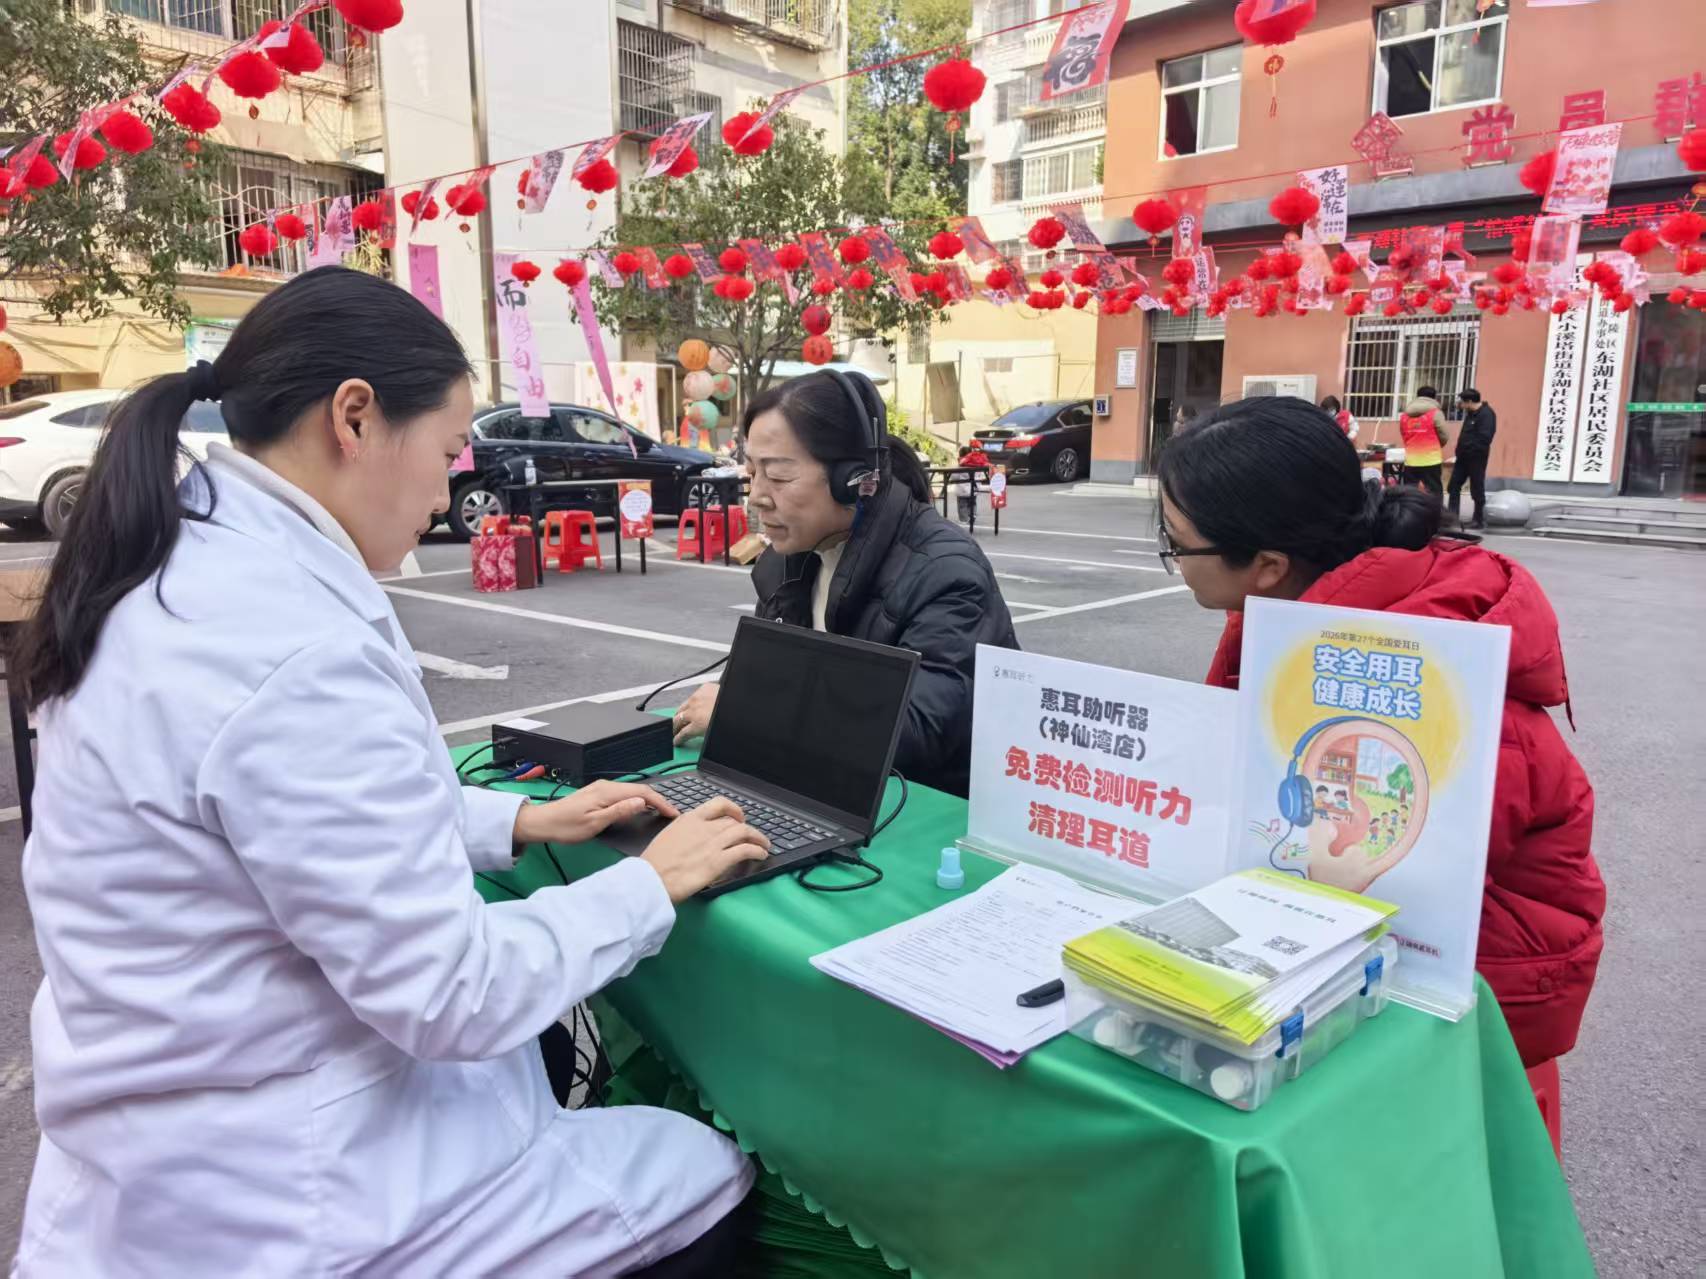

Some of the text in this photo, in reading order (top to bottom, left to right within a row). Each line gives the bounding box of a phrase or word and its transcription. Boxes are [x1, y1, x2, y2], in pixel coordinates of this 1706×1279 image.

[1583, 351, 1616, 472] 东湖社区居民委员会
[1313, 644, 1423, 687] 安全用耳
[1040, 687, 1149, 732] 惠耳助听器
[1312, 675, 1422, 720] 健康成长
[1005, 746, 1192, 825] 免费检测听力
[1028, 801, 1151, 868] 清理耳道
